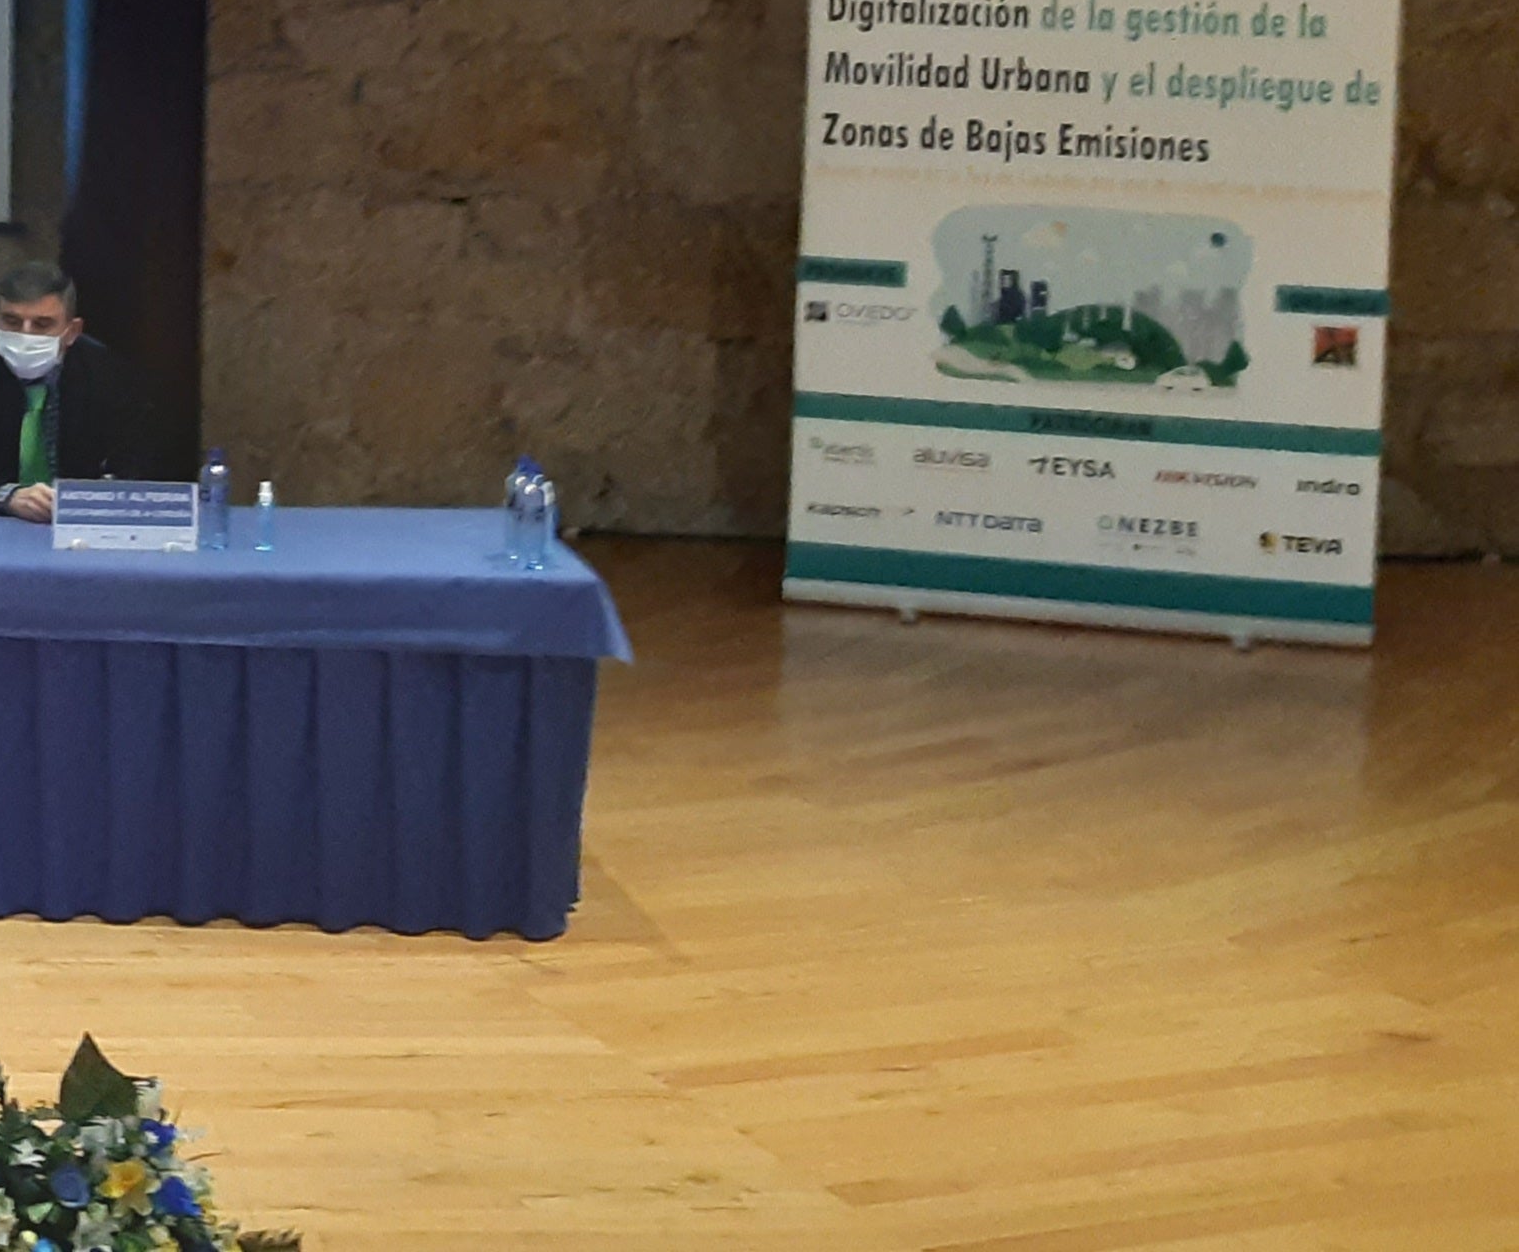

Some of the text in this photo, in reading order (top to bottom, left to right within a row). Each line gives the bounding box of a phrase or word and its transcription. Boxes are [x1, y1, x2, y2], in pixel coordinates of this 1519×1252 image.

[1126, 1, 1239, 41] gestión
[1251, 2, 1286, 37] de
[1299, 2, 1326, 38] la
[824, 51, 1381, 111] Movilidad Urbana y el despliegue de
[822, 113, 1210, 163] Zonas de Bajas Emisiones
[1053, 457, 1115, 479] EYSA
[1281, 534, 1344, 555] TEVA
